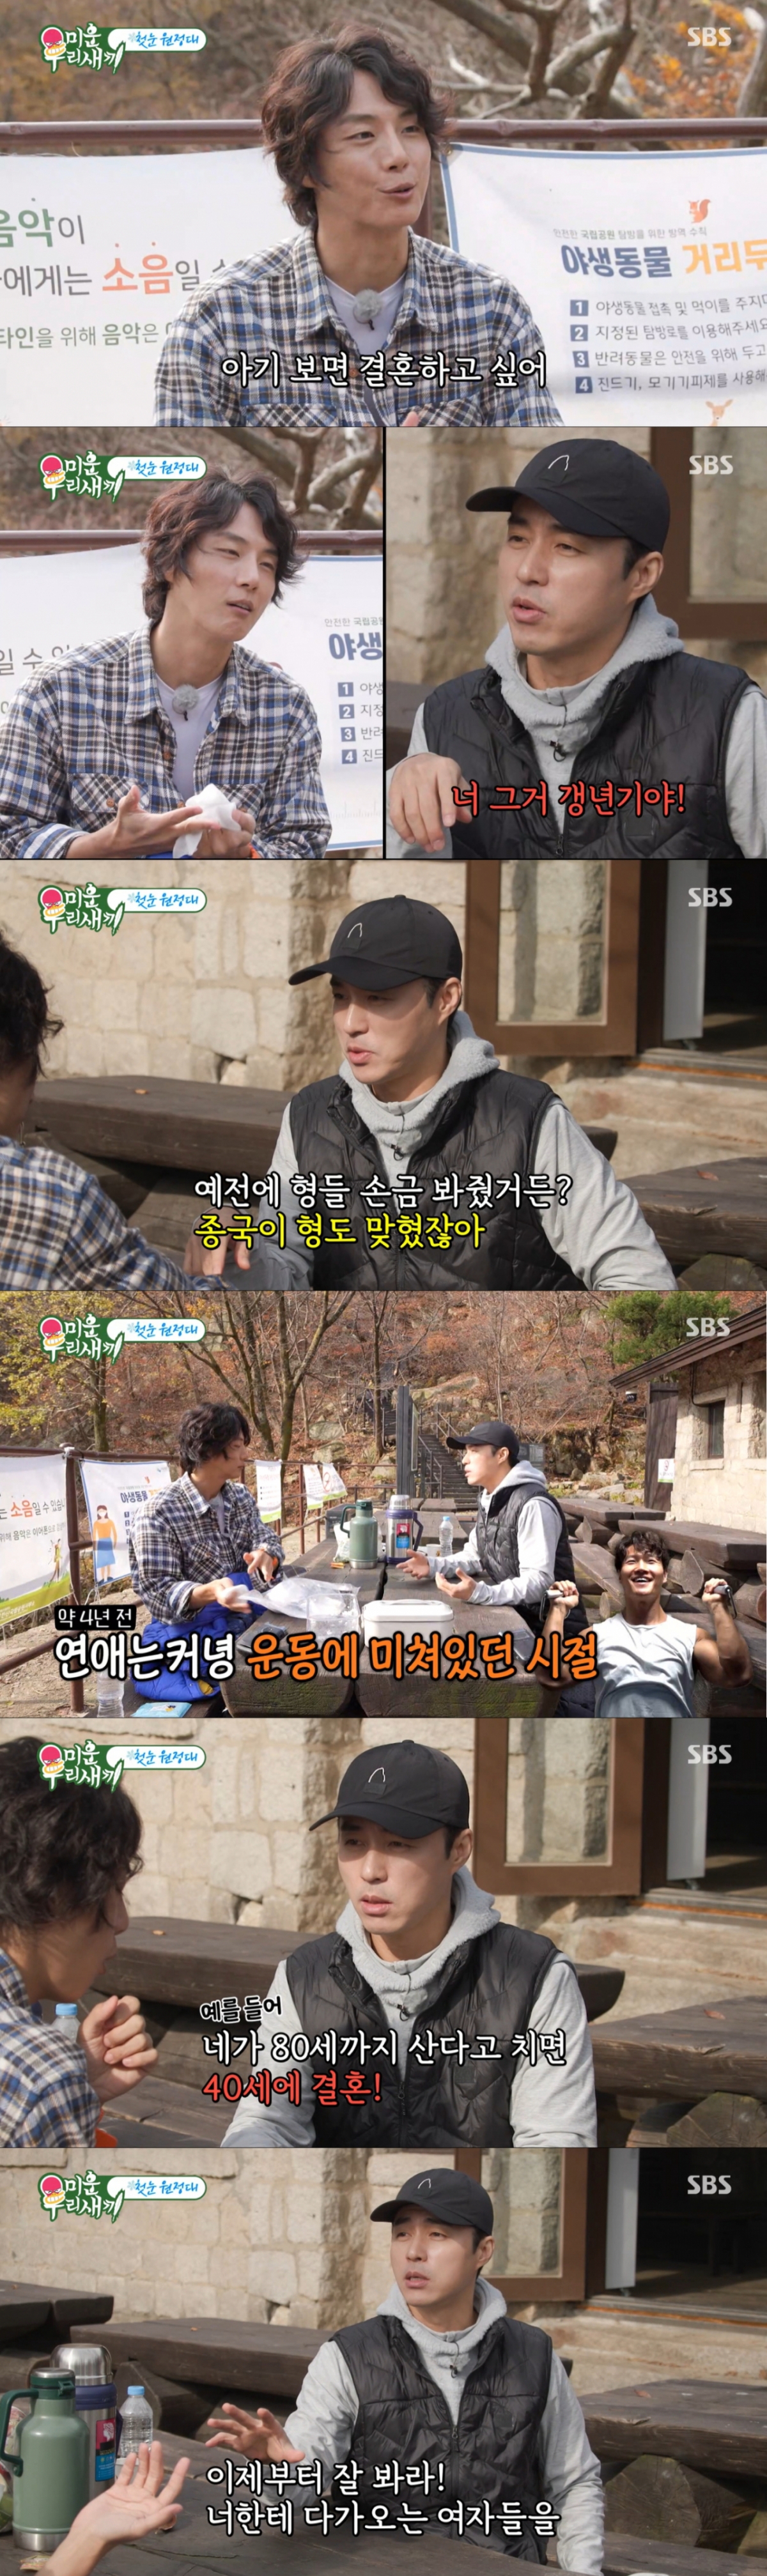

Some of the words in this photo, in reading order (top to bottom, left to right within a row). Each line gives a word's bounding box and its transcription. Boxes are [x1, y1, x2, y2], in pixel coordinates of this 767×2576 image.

[580, 229, 616, 240] 국립공원
[618, 229, 644, 240] 탐방을
[648, 228, 665, 238] 위한
[669, 227, 686, 238] 방역
[561, 245, 672, 279] 야생동물
[682, 239, 767, 275] 거리두
[0, 265, 92, 296] 에게는
[102, 254, 200, 295] 소음일
[596, 301, 647, 316] 야생동물
[648, 302, 672, 316] 접촉
[675, 301, 688, 316] 및
[692, 298, 731, 314] 먹이를
[60, 326, 97, 347] 위해
[102, 322, 159, 346] 음악은
[595, 326, 639, 341] 지정된
[643, 325, 689, 341] 탐방로를
[692, 318, 767, 339] 이용해주세요
[595, 351, 667, 367] 반려동물은
[671, 350, 707, 365] 안전을
[711, 347, 738, 362] 위해
[741, 344, 767, 360] 두고
[598, 376, 642, 392] 진드기,
[648, 372, 728, 391] 모기기피제를
[732, 369, 767, 386] 사용해
[324, 617, 351, 627] 안전한
[329, 631, 383, 661] 야생
[360, 682, 383, 696] 야생
[120, 1491, 148, 1503] 야생동물
[10, 1499, 42, 1518] 소음일
[42, 1501, 50, 1514] 수
[13, 1529, 31, 1541] 음악은
